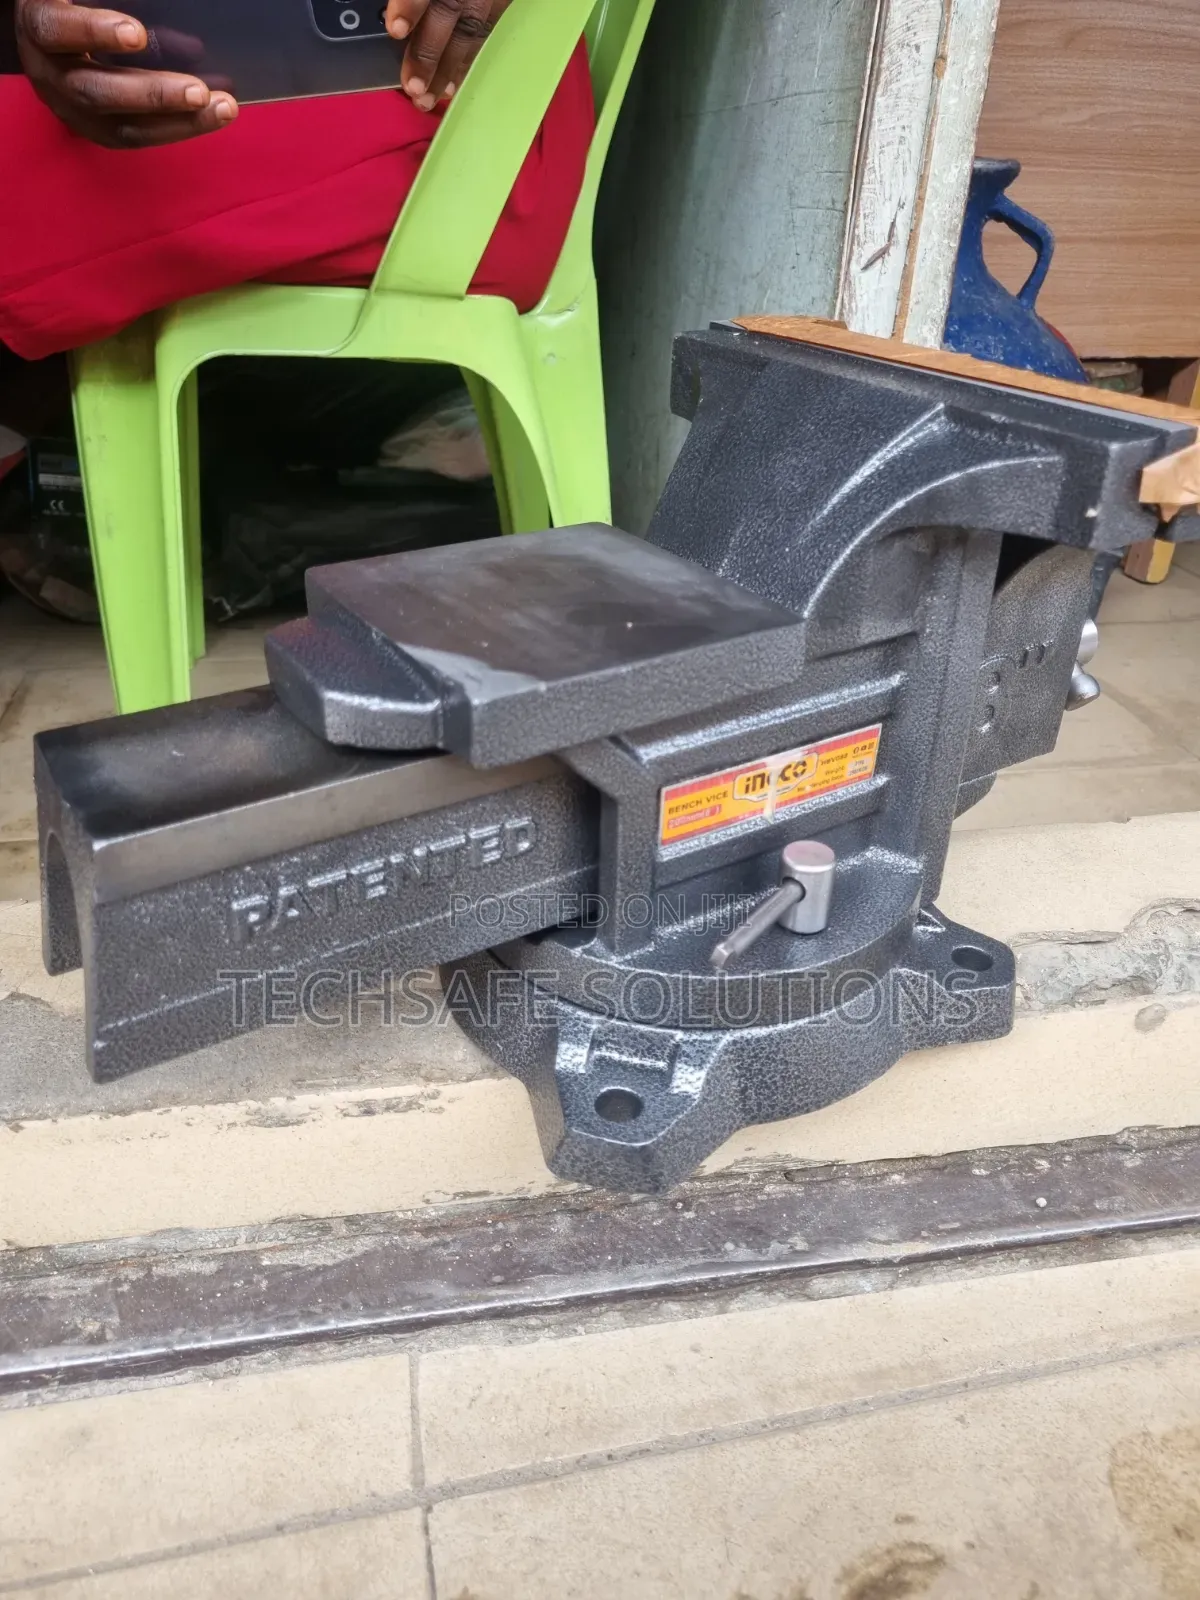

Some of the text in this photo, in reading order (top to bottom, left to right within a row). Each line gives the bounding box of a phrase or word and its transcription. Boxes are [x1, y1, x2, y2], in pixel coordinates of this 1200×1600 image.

[668, 790, 729, 815] BENCH VICE
[231, 816, 538, 942] PATENTED
